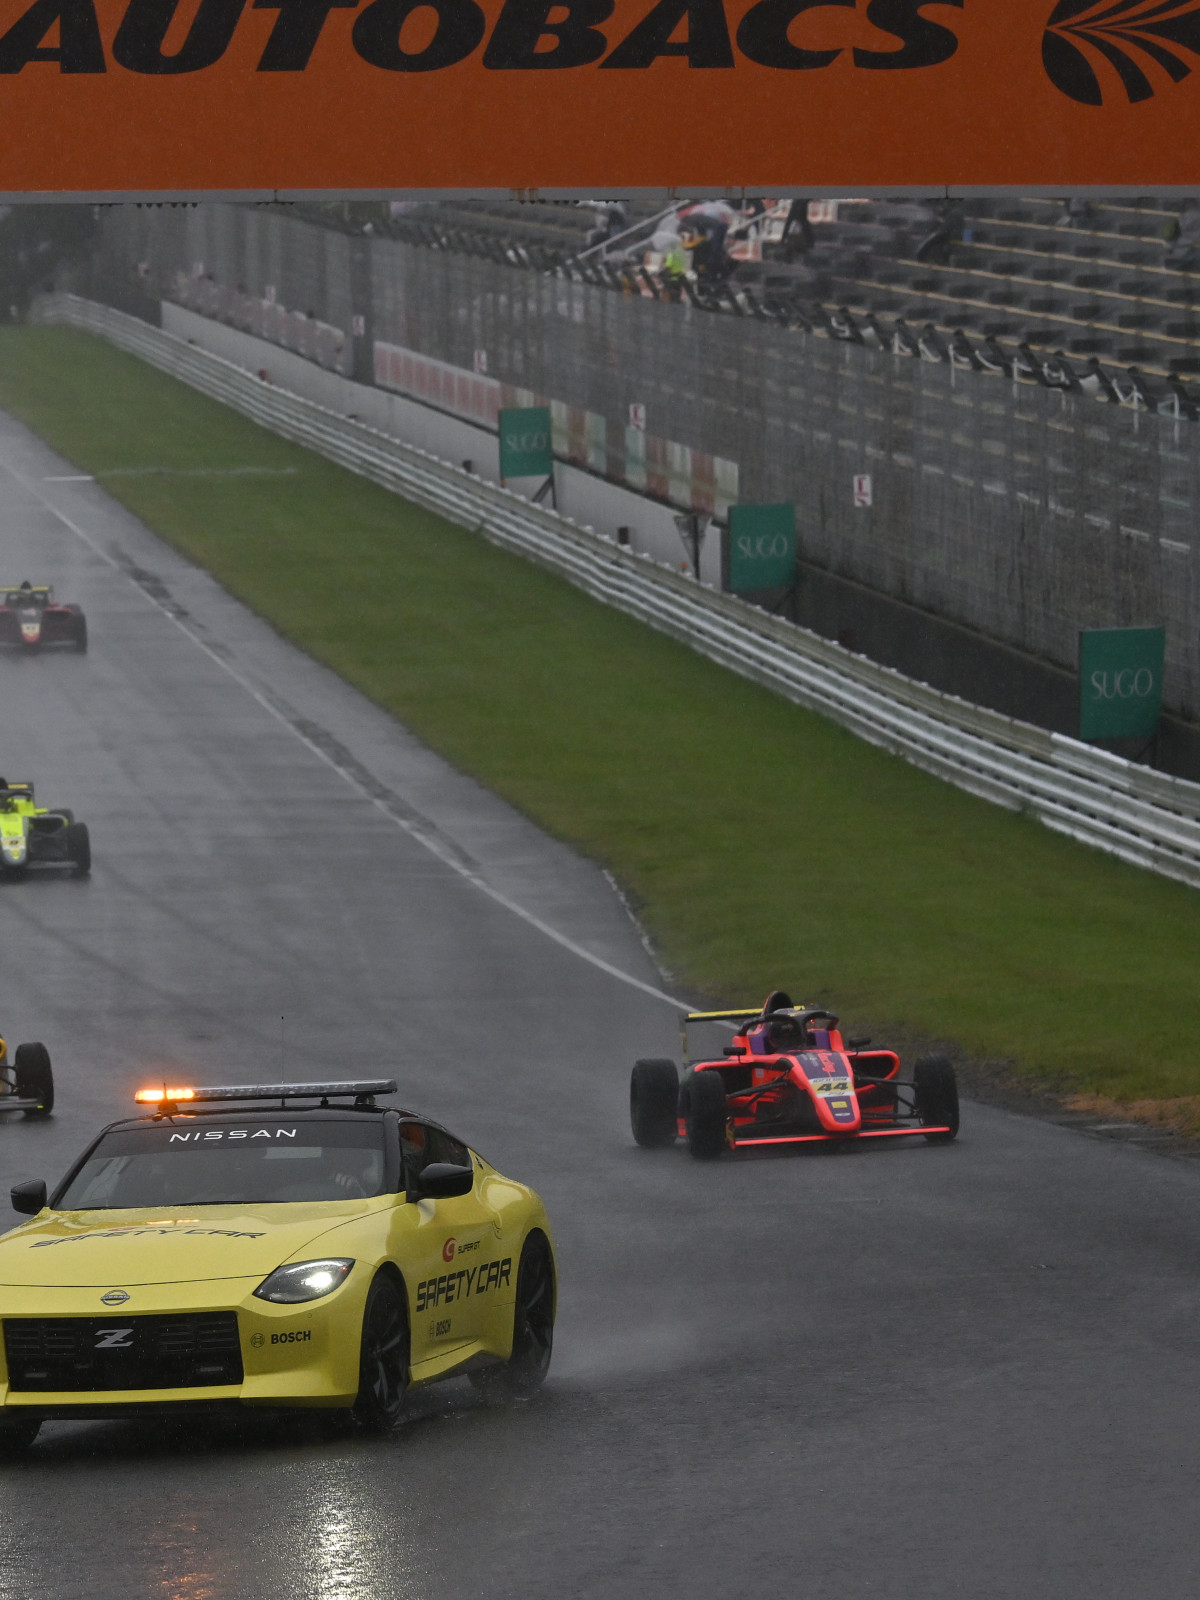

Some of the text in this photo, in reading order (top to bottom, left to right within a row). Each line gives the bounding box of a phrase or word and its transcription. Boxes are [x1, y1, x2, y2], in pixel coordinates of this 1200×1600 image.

[506, 430, 548, 450] SUGO
[737, 534, 788, 559] SUGO
[1090, 667, 1153, 700] SUGO
[816, 1082, 849, 1092] 44
[169, 1128, 297, 1143] NISSAN
[28, 1229, 266, 1249] SAFETY CAR
[457, 1243, 474, 1254] SUPER
[416, 1257, 512, 1312] SAFETY CAR
[93, 1328, 135, 1348] Z
[270, 1330, 312, 1345] BOSCH
[435, 1319, 452, 1337] BOSCH
